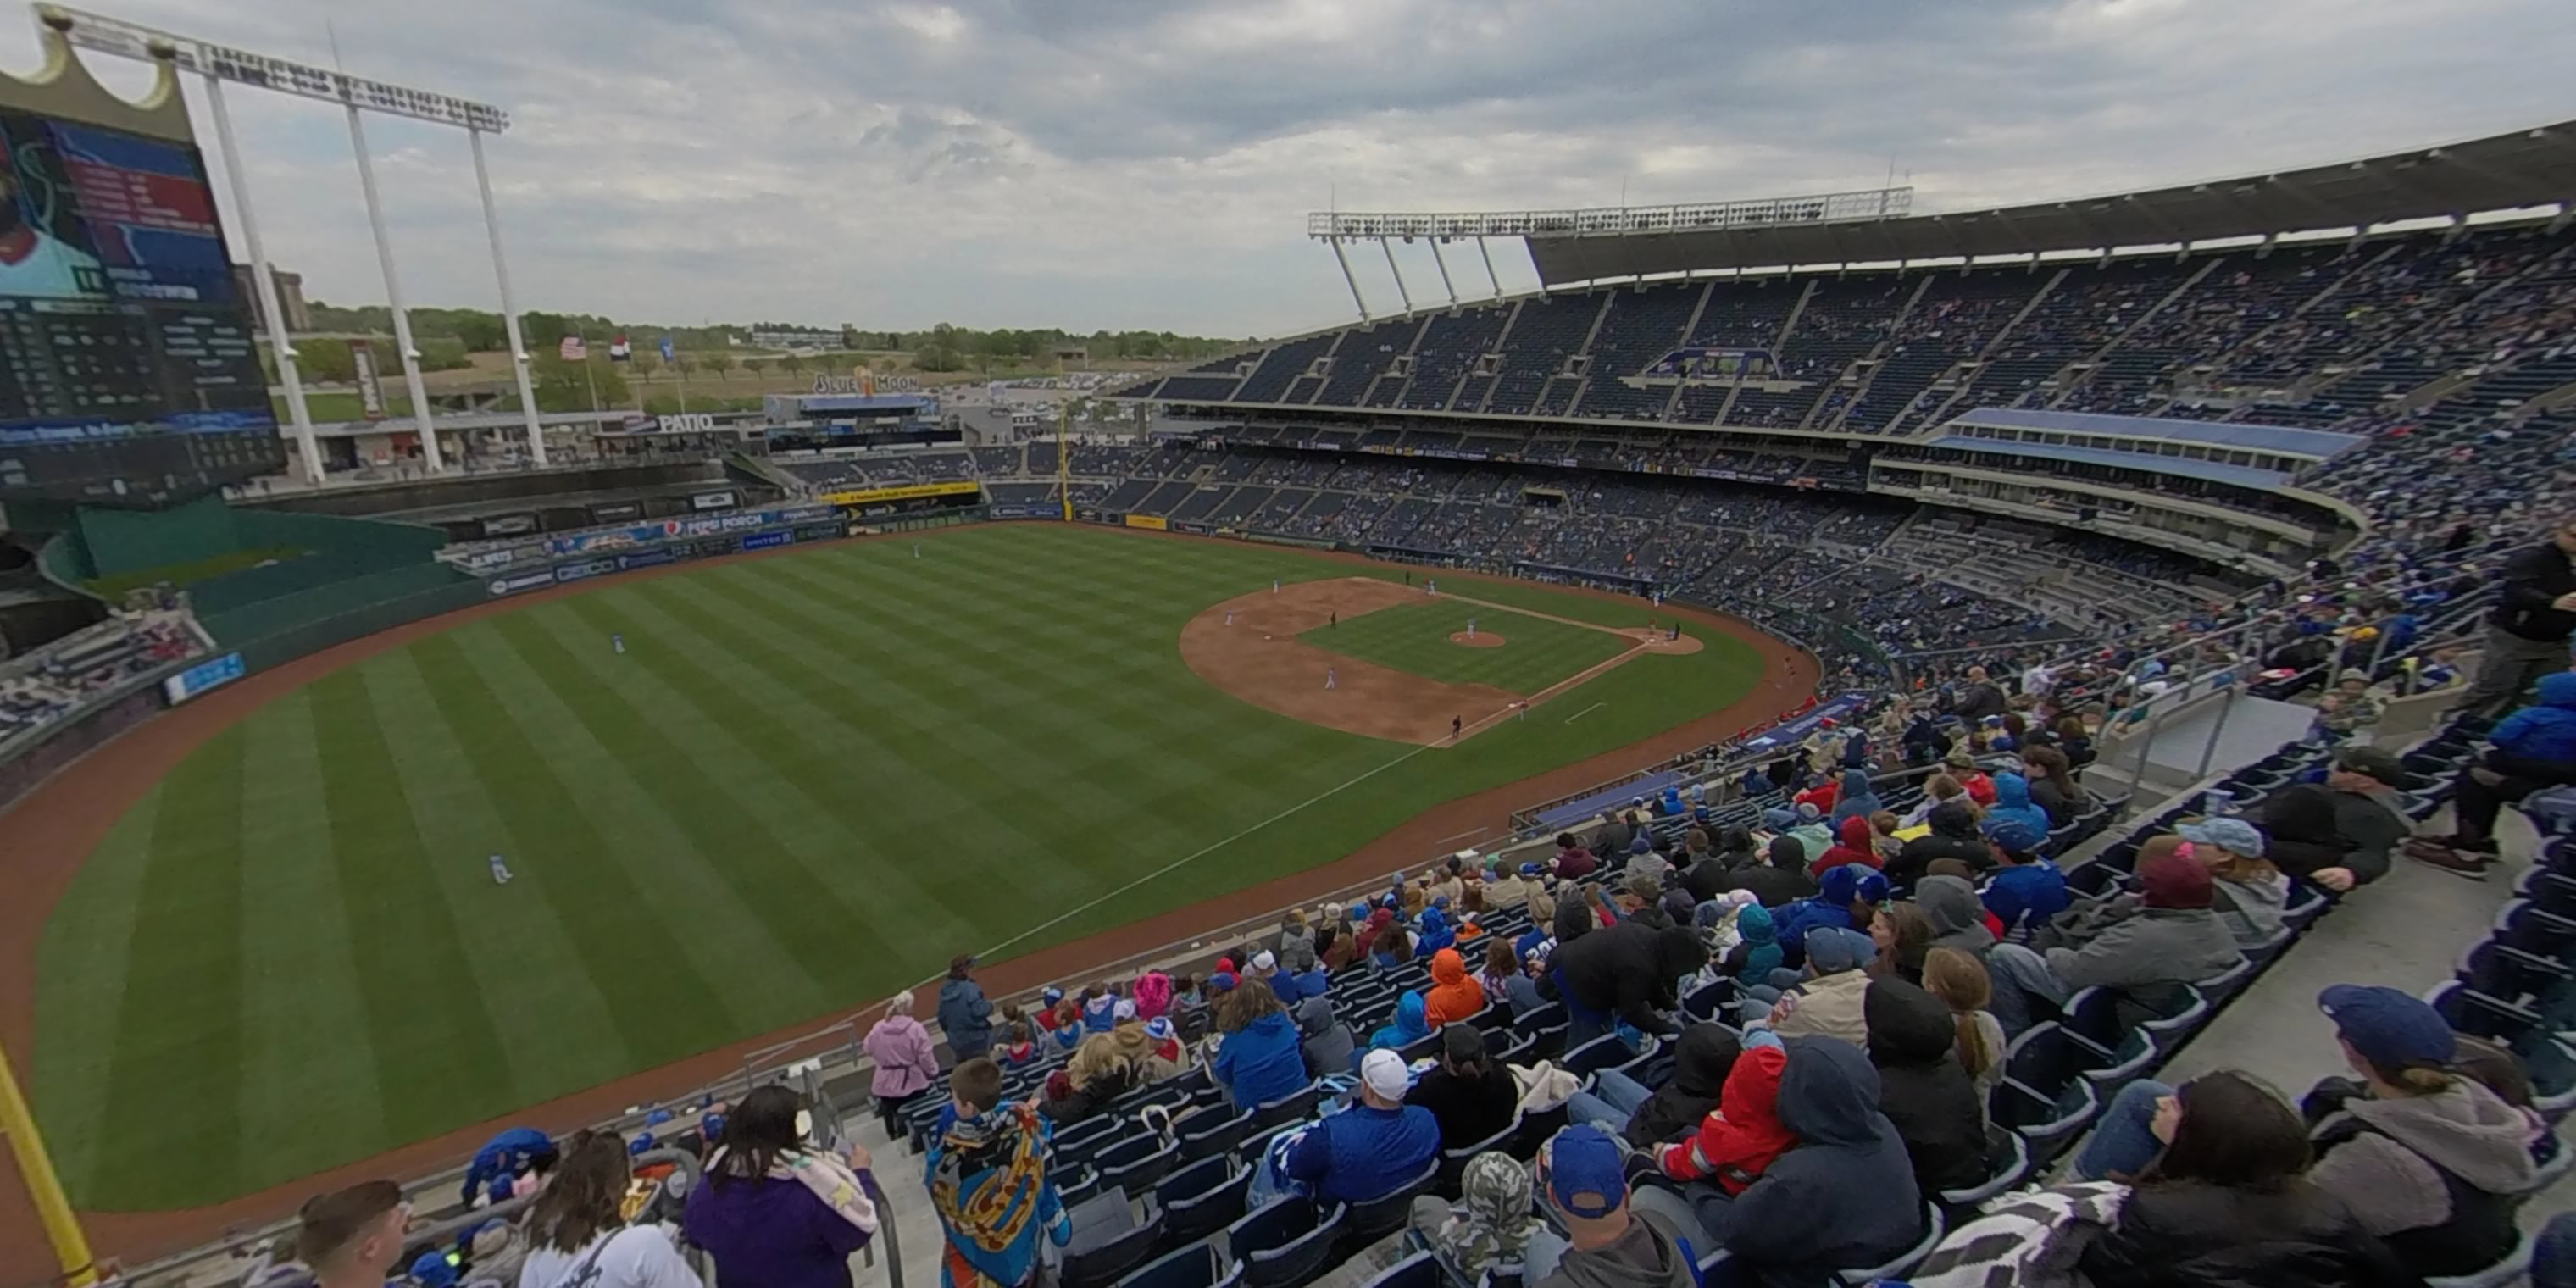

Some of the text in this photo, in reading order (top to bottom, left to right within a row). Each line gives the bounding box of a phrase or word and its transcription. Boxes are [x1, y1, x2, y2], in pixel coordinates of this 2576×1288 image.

[814, 373, 921, 395] BLUE MOON
[658, 413, 714, 433] PATIO
[721, 514, 763, 531] PORCH
[558, 560, 614, 580] GEICO
